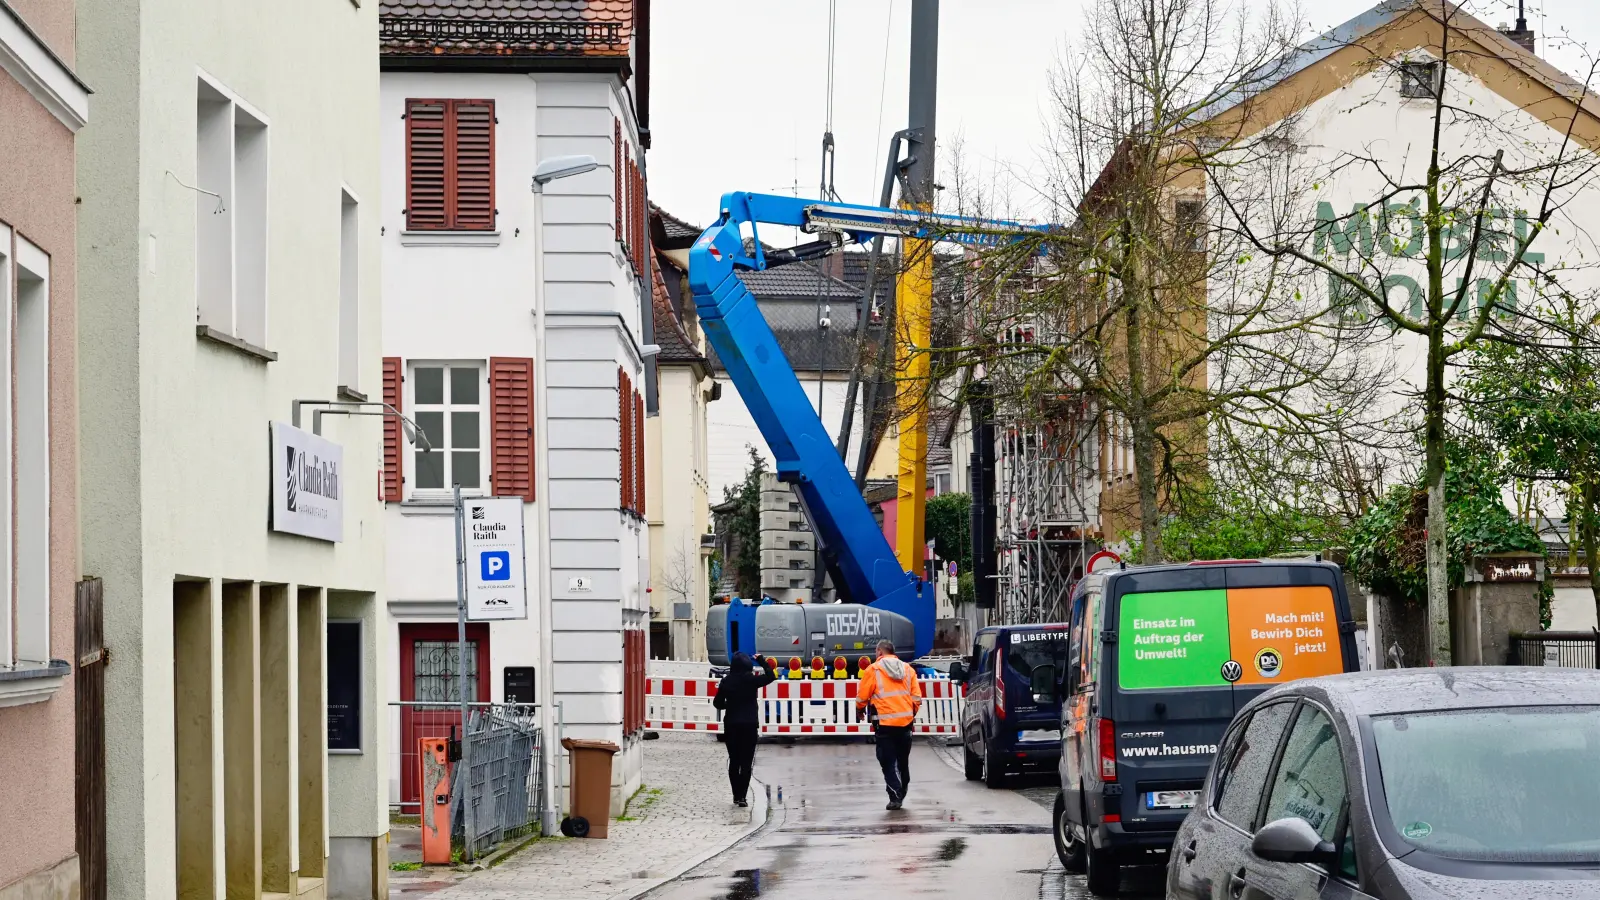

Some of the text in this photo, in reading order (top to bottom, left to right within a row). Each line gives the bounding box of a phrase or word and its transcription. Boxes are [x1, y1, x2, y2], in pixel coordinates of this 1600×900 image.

[1313, 196, 1545, 264] MÖBEL
[298, 451, 337, 500] Claudia Raith
[473, 523, 506, 532] Claudia
[473, 531, 497, 540] Raith
[488, 557, 503, 575] P
[577, 578, 583, 588] 9
[826, 608, 881, 636] GOSSNER
[1133, 617, 1195, 629] Einsatz im
[1265, 611, 1325, 623] Mach mit!
[1022, 632, 1069, 642] LIBERTYPE
[1134, 632, 1204, 645] Auftrag der
[1251, 627, 1323, 639] Bewirb Dich
[1135, 648, 1187, 660] Umwelt!
[1294, 641, 1326, 655] jetzt!
[1121, 731, 1165, 739] CRAFTER
[1122, 743, 1220, 757] www.hausma
